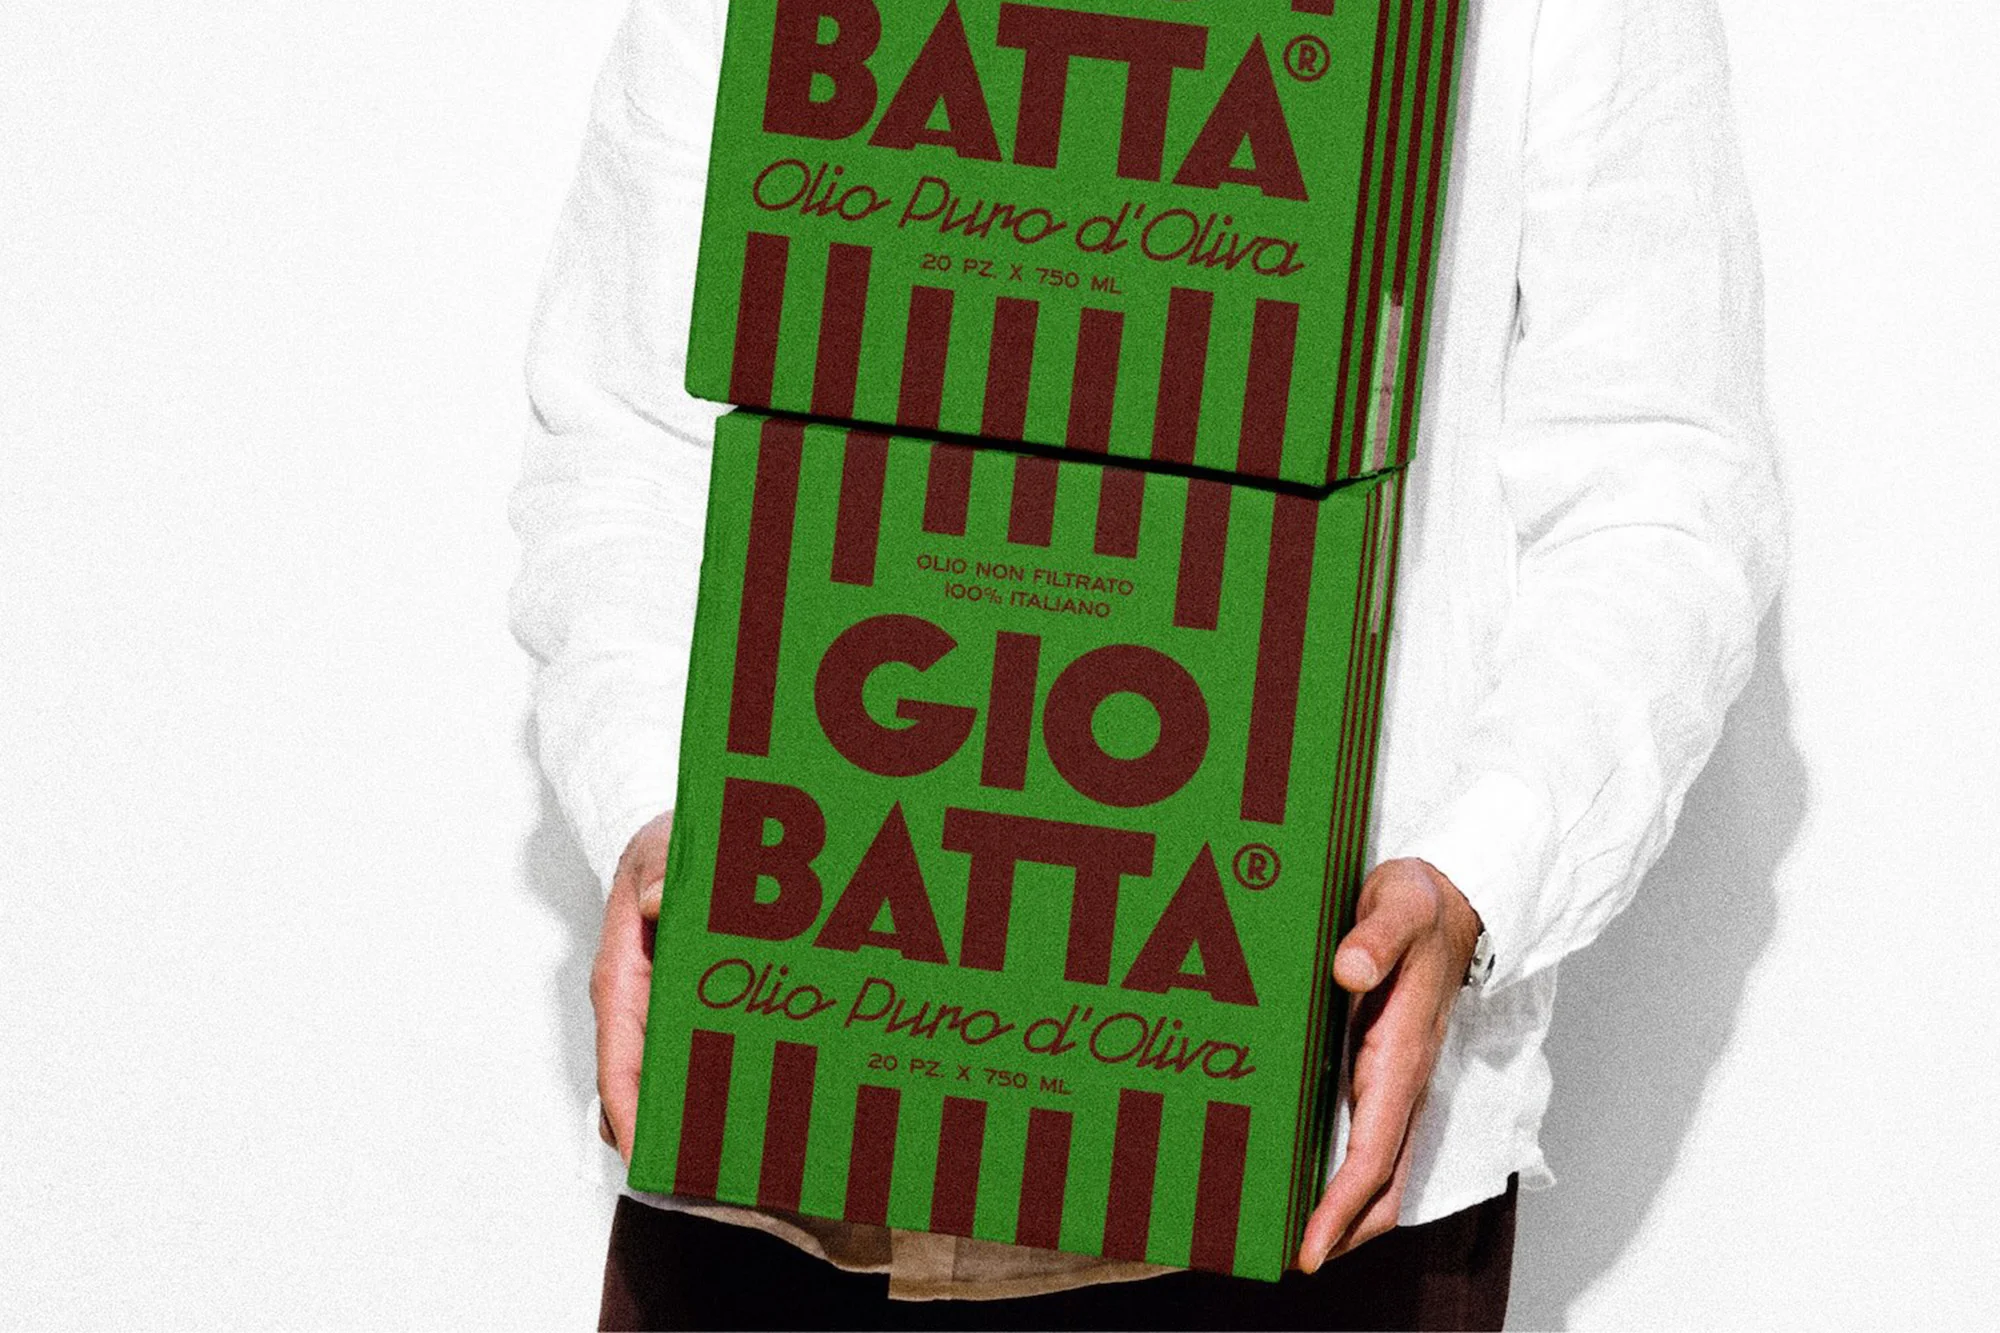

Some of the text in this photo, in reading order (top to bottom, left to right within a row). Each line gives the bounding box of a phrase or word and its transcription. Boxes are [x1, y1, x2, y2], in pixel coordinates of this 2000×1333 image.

[753, 158, 1305, 277] Olio Puro d'Oliva
[920, 253, 952, 272] 20
[1036, 267, 1080, 289] 750
[1090, 275, 1122, 295] ML
[916, 554, 1134, 596] OLIO NON FILTRATO
[944, 581, 1111, 618] 100% ITALIANO
[814, 614, 1210, 808] GIO
[697, 958, 1256, 1080] Olio Puro d'Oliva
[867, 1053, 898, 1072] 20
[984, 1068, 1028, 1089] 750
[1039, 1076, 1073, 1096] ML
